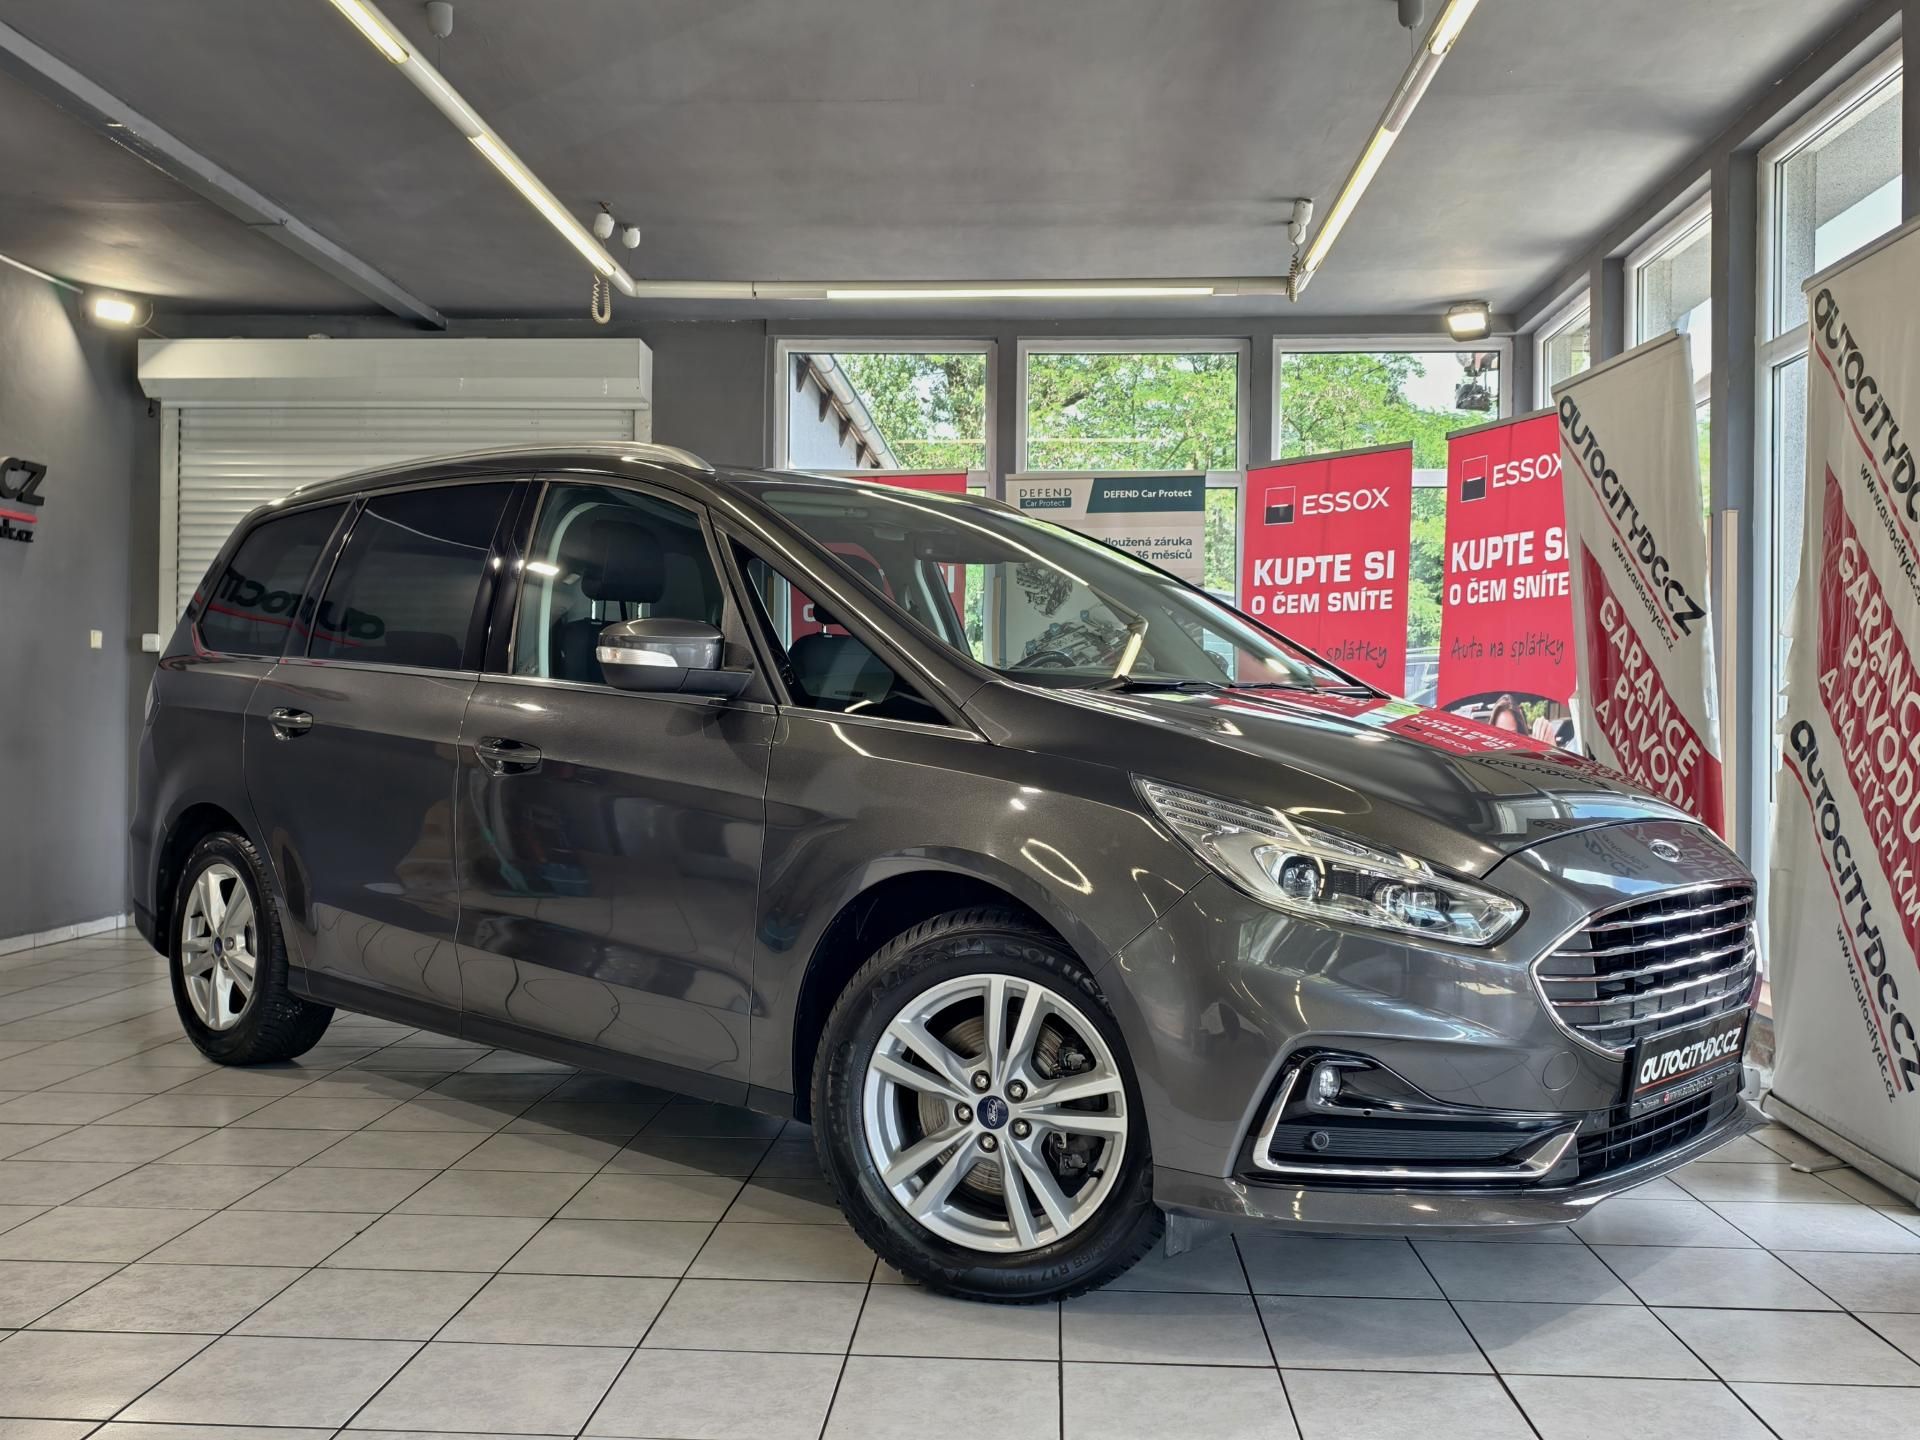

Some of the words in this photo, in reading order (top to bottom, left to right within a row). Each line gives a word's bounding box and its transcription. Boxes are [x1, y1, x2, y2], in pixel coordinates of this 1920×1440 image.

[1492, 453, 1562, 488] ESSOX
[1019, 488, 1072, 498] DEFEND
[1025, 500, 1038, 508] Car
[1038, 500, 1065, 508] Protect
[1103, 490, 1140, 499] DEFEND
[1141, 490, 1156, 498] Car
[1158, 489, 1193, 498] Protect
[1302, 487, 1391, 515] ESSOX
[1102, 536, 1152, 547] dloužená
[1154, 536, 1193, 547] záruka
[1151, 549, 1193, 560] měsíců
[1451, 530, 1535, 574] KUPTE
[1253, 553, 1352, 587] KUPTE
[1364, 550, 1396, 581] SI
[1251, 595, 1266, 615] O
[1272, 591, 1320, 615] ČEM
[1327, 587, 1393, 613] SNÍTE
[1449, 583, 1461, 606] O
[1466, 577, 1507, 605] ČEM
[1513, 569, 1570, 600] SNÍTE
[1451, 636, 1483, 660] Auta
[1490, 642, 1504, 659] na
[1510, 631, 1564, 665] splátky
[1600, 596, 1701, 778] GARANCE
[1820, 667, 1838, 698] A
[1596, 699, 1610, 725] A
[1614, 674, 1703, 822] PŮVOD
[1836, 923, 1896, 1104] www.autocitydc.cz
